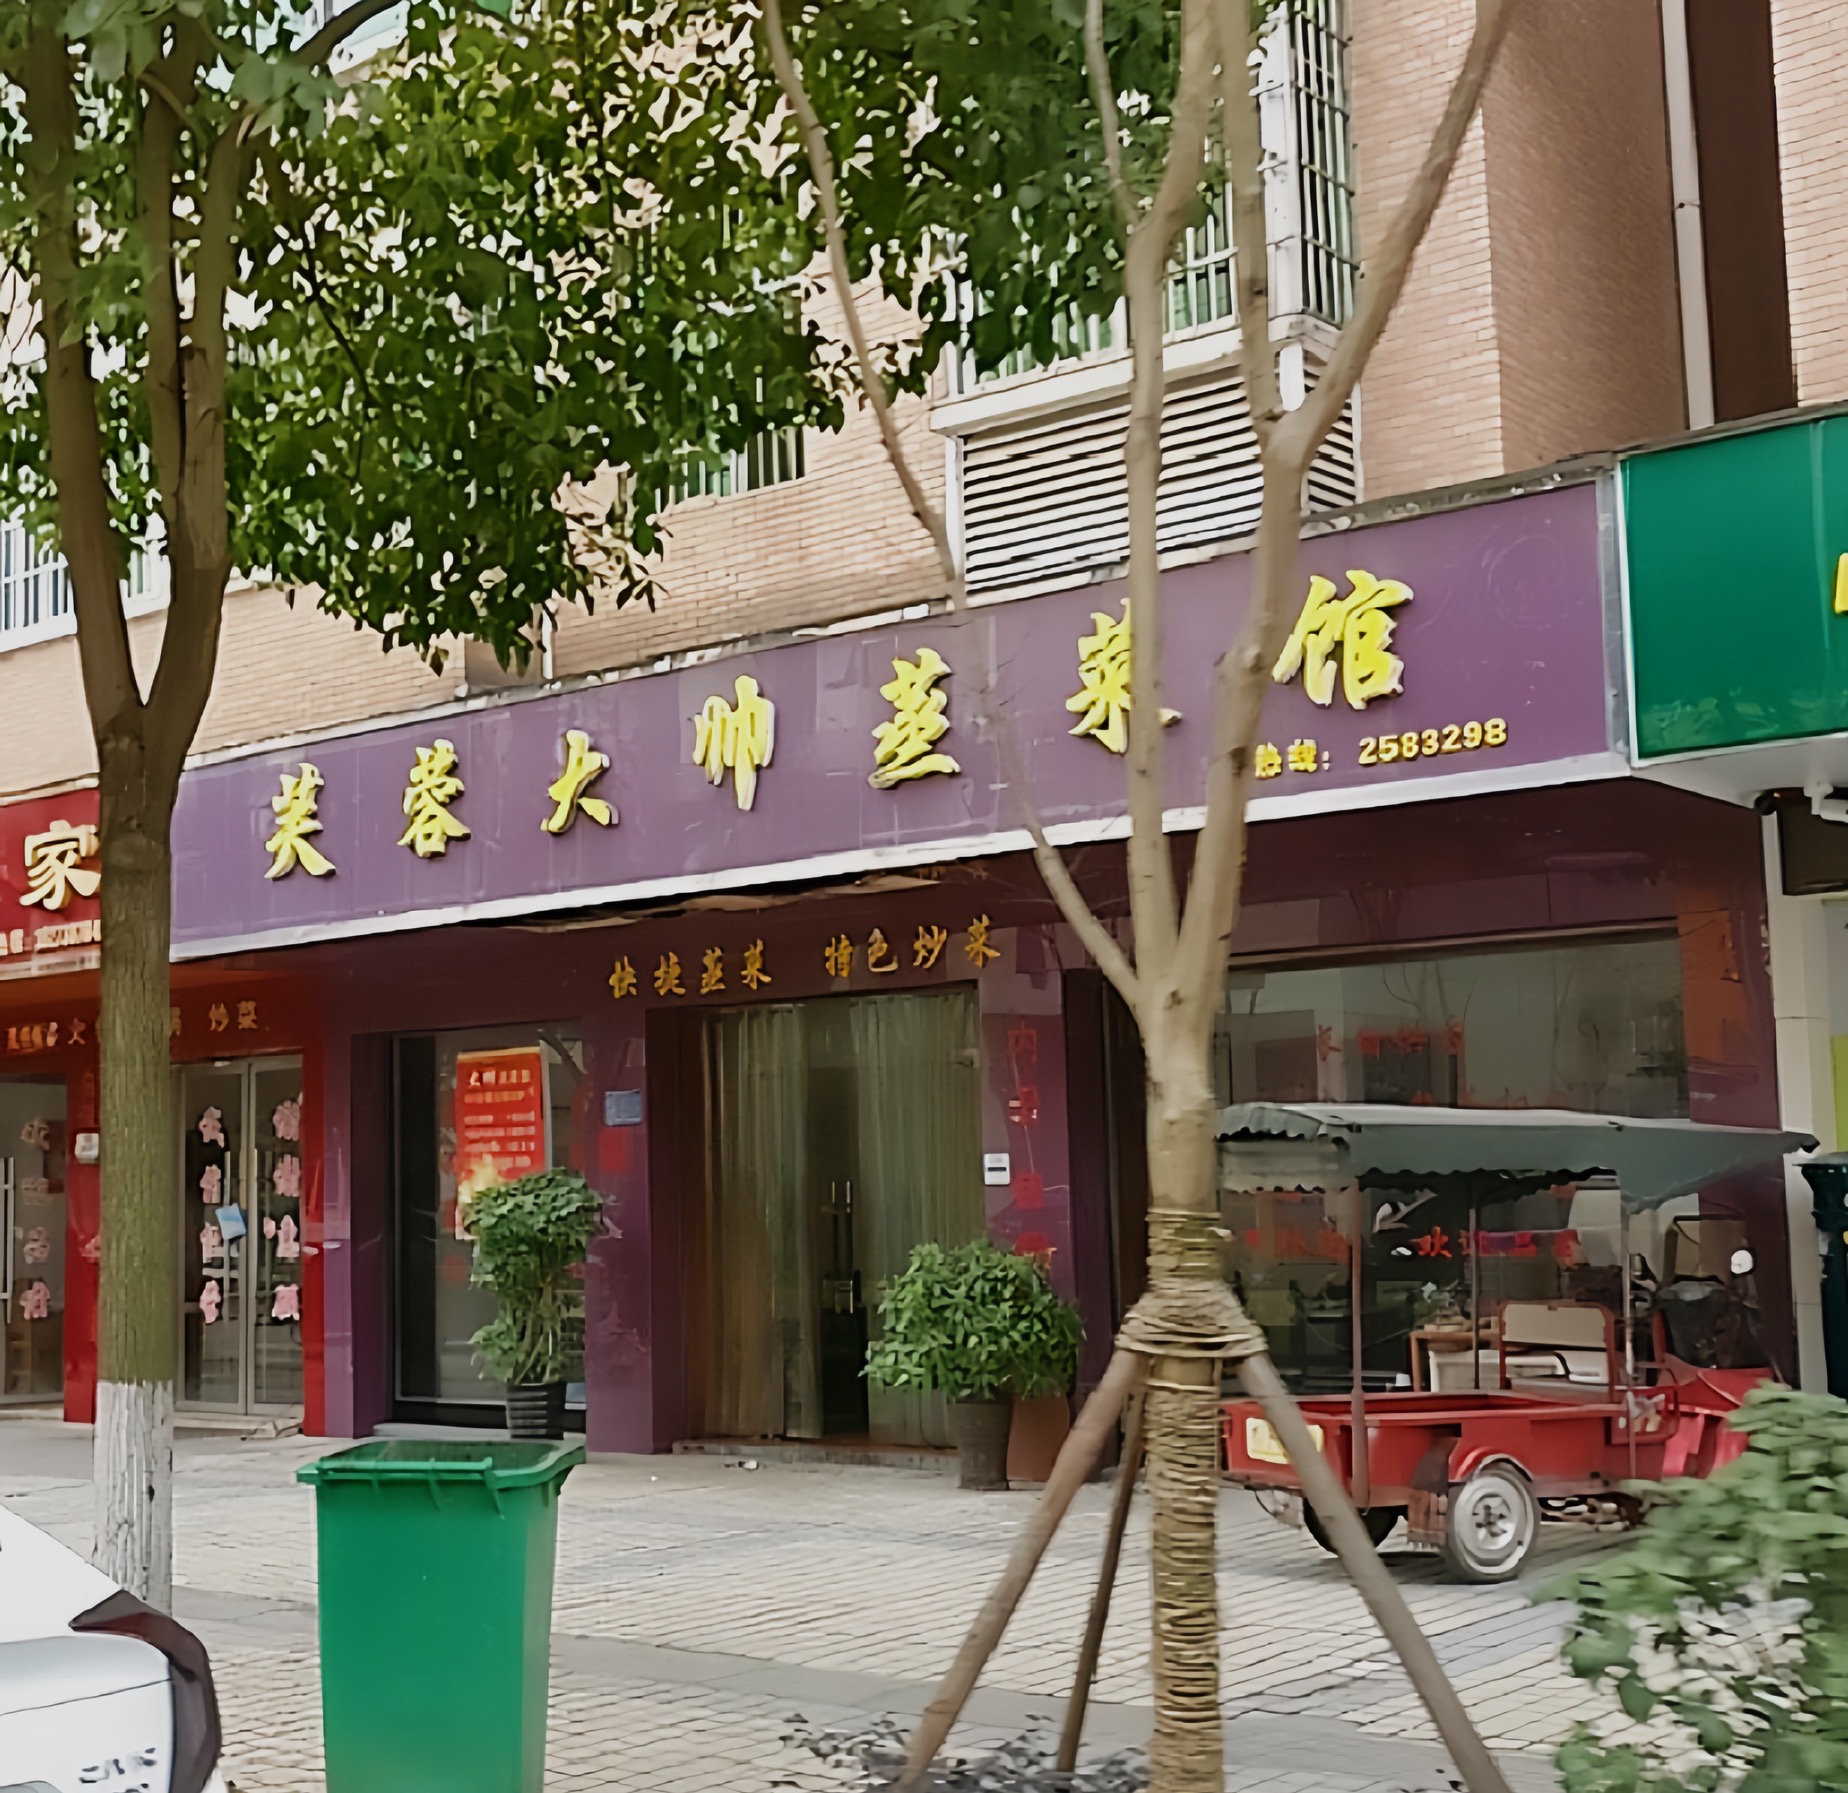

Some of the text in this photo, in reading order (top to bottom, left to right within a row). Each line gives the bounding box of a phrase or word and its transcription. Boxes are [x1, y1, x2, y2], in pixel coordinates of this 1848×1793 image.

[1358, 717, 1508, 766] 2583298
[824, 914, 1001, 978] 特色炒菜
